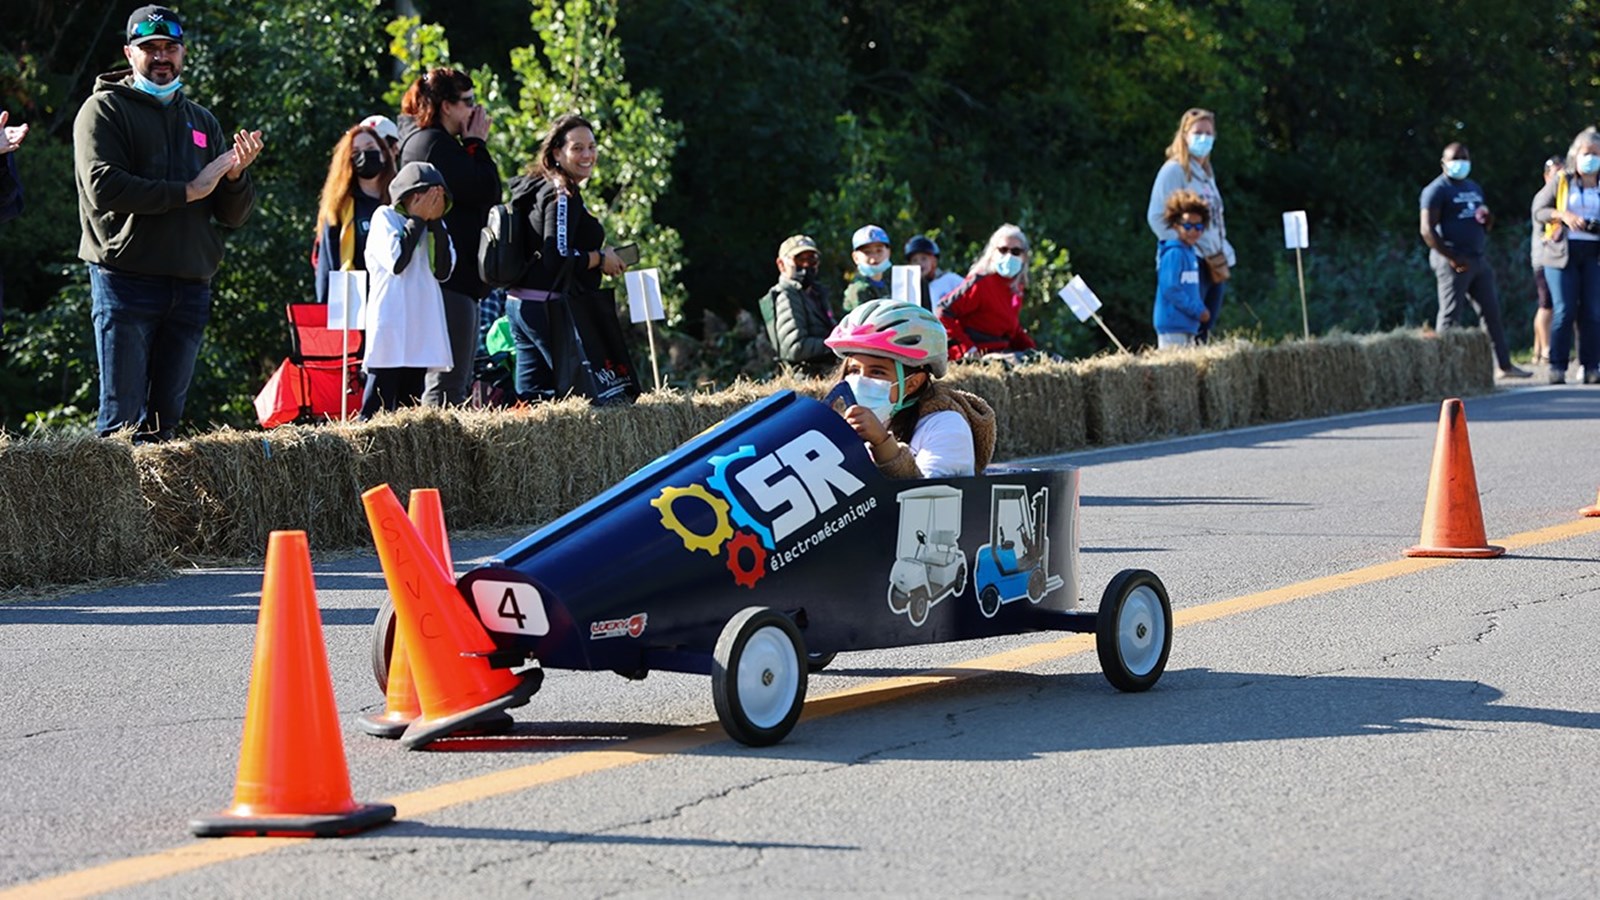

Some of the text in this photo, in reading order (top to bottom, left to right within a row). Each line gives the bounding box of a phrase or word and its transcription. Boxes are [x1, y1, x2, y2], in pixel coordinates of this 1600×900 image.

[734, 429, 866, 543] SR
[770, 494, 877, 572] électromécanique
[497, 587, 526, 630] 4
